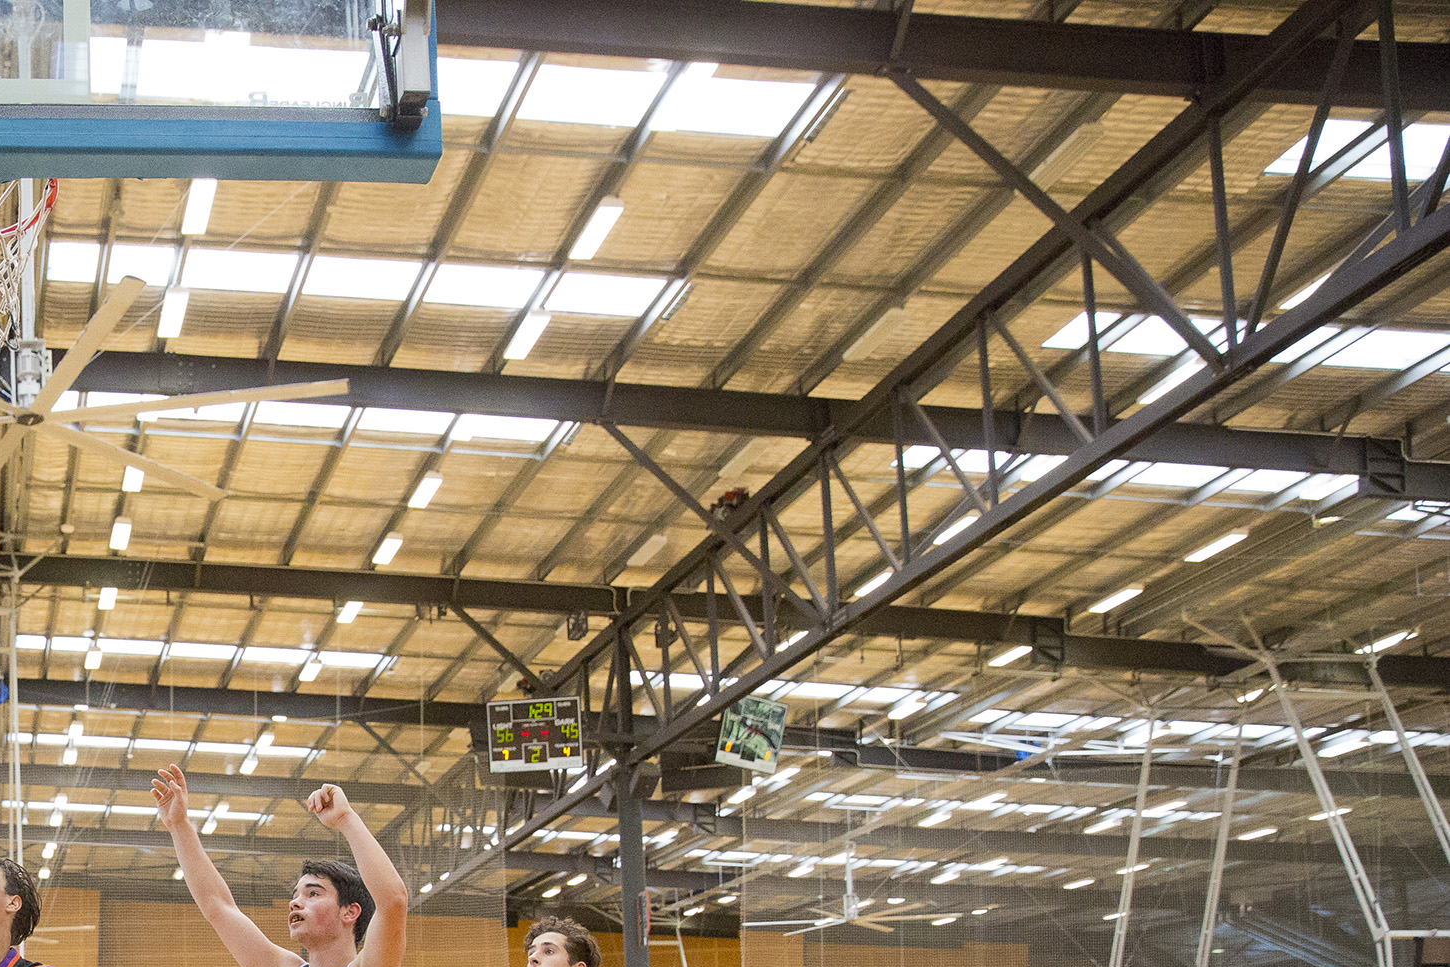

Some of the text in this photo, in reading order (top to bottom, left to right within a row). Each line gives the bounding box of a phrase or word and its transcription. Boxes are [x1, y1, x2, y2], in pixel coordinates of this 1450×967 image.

[496, 723, 579, 743] 56 45
[531, 748, 541, 763] 2
